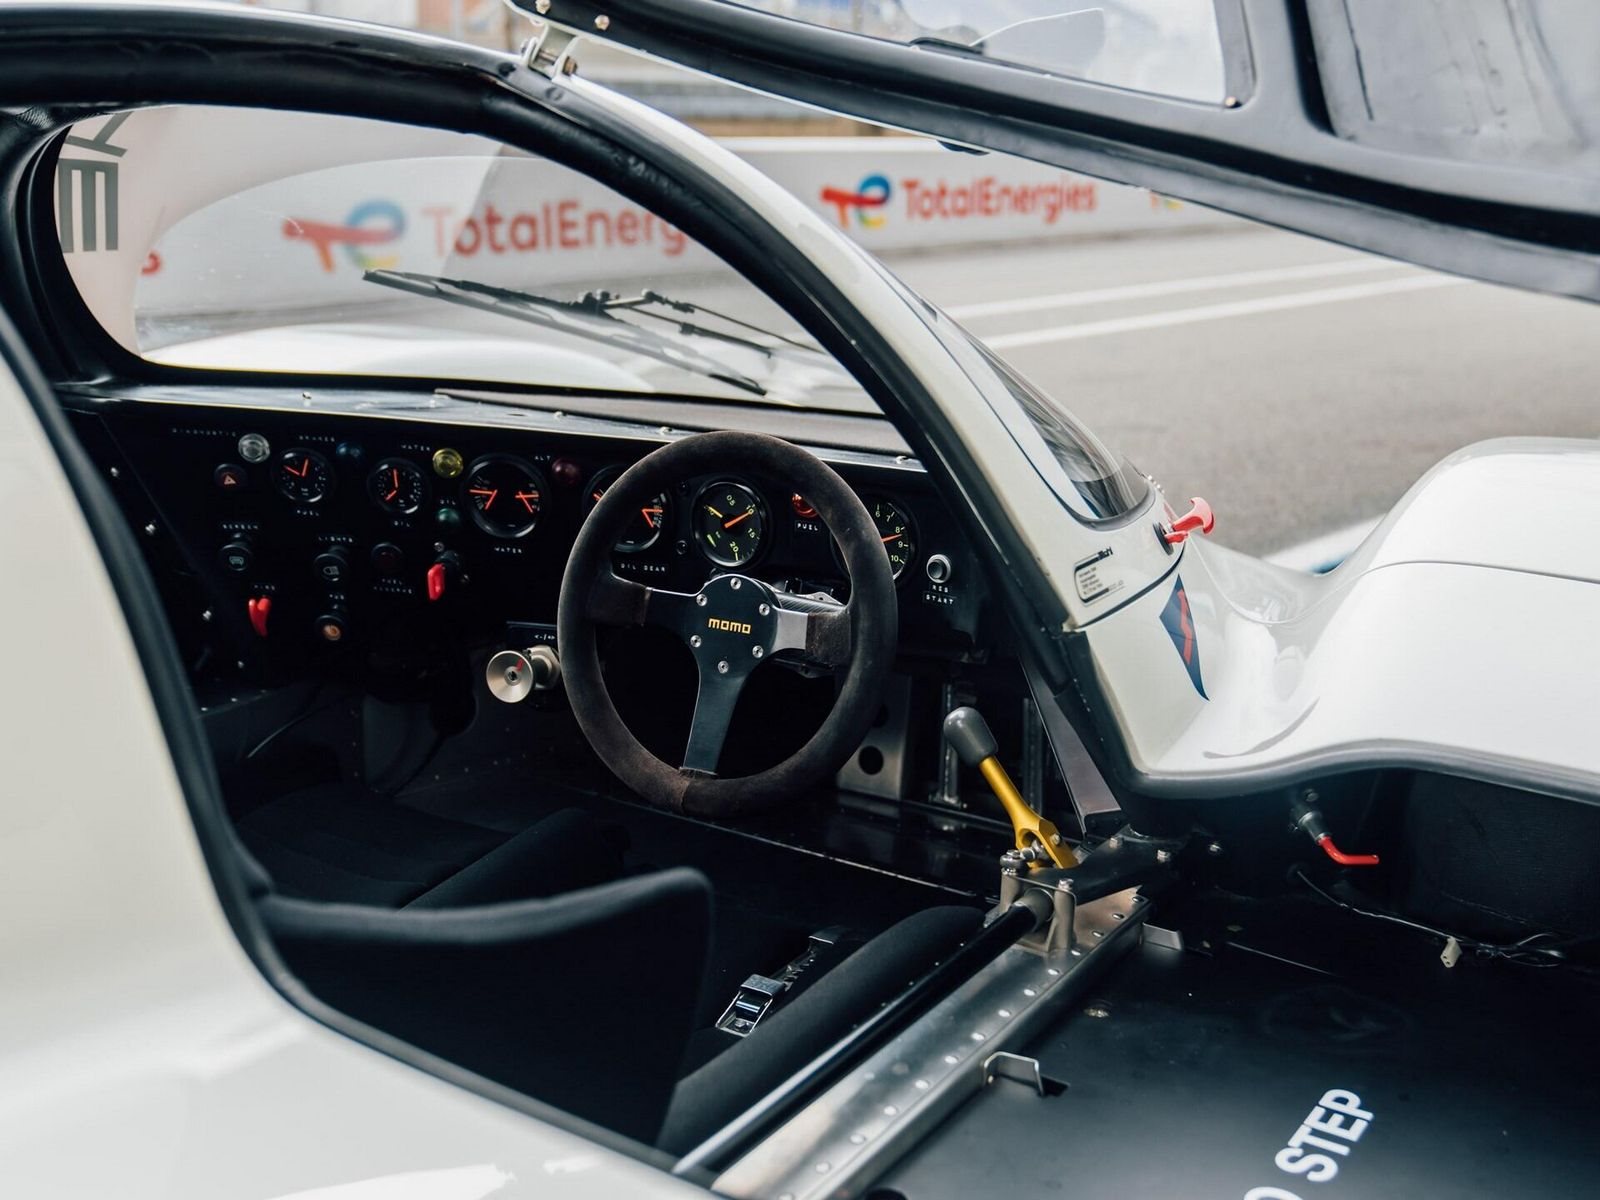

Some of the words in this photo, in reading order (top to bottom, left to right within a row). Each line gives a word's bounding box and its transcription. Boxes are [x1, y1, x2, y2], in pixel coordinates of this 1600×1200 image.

[902, 176, 1098, 225] TotalEnergies
[421, 199, 688, 257] TotalEnerg
[797, 523, 819, 531] FUEL
[895, 526, 901, 534] 8
[729, 541, 739, 552] 20
[890, 554, 899, 562] 10
[925, 594, 954, 605] START
[1274, 1088, 1374, 1183] STEP
